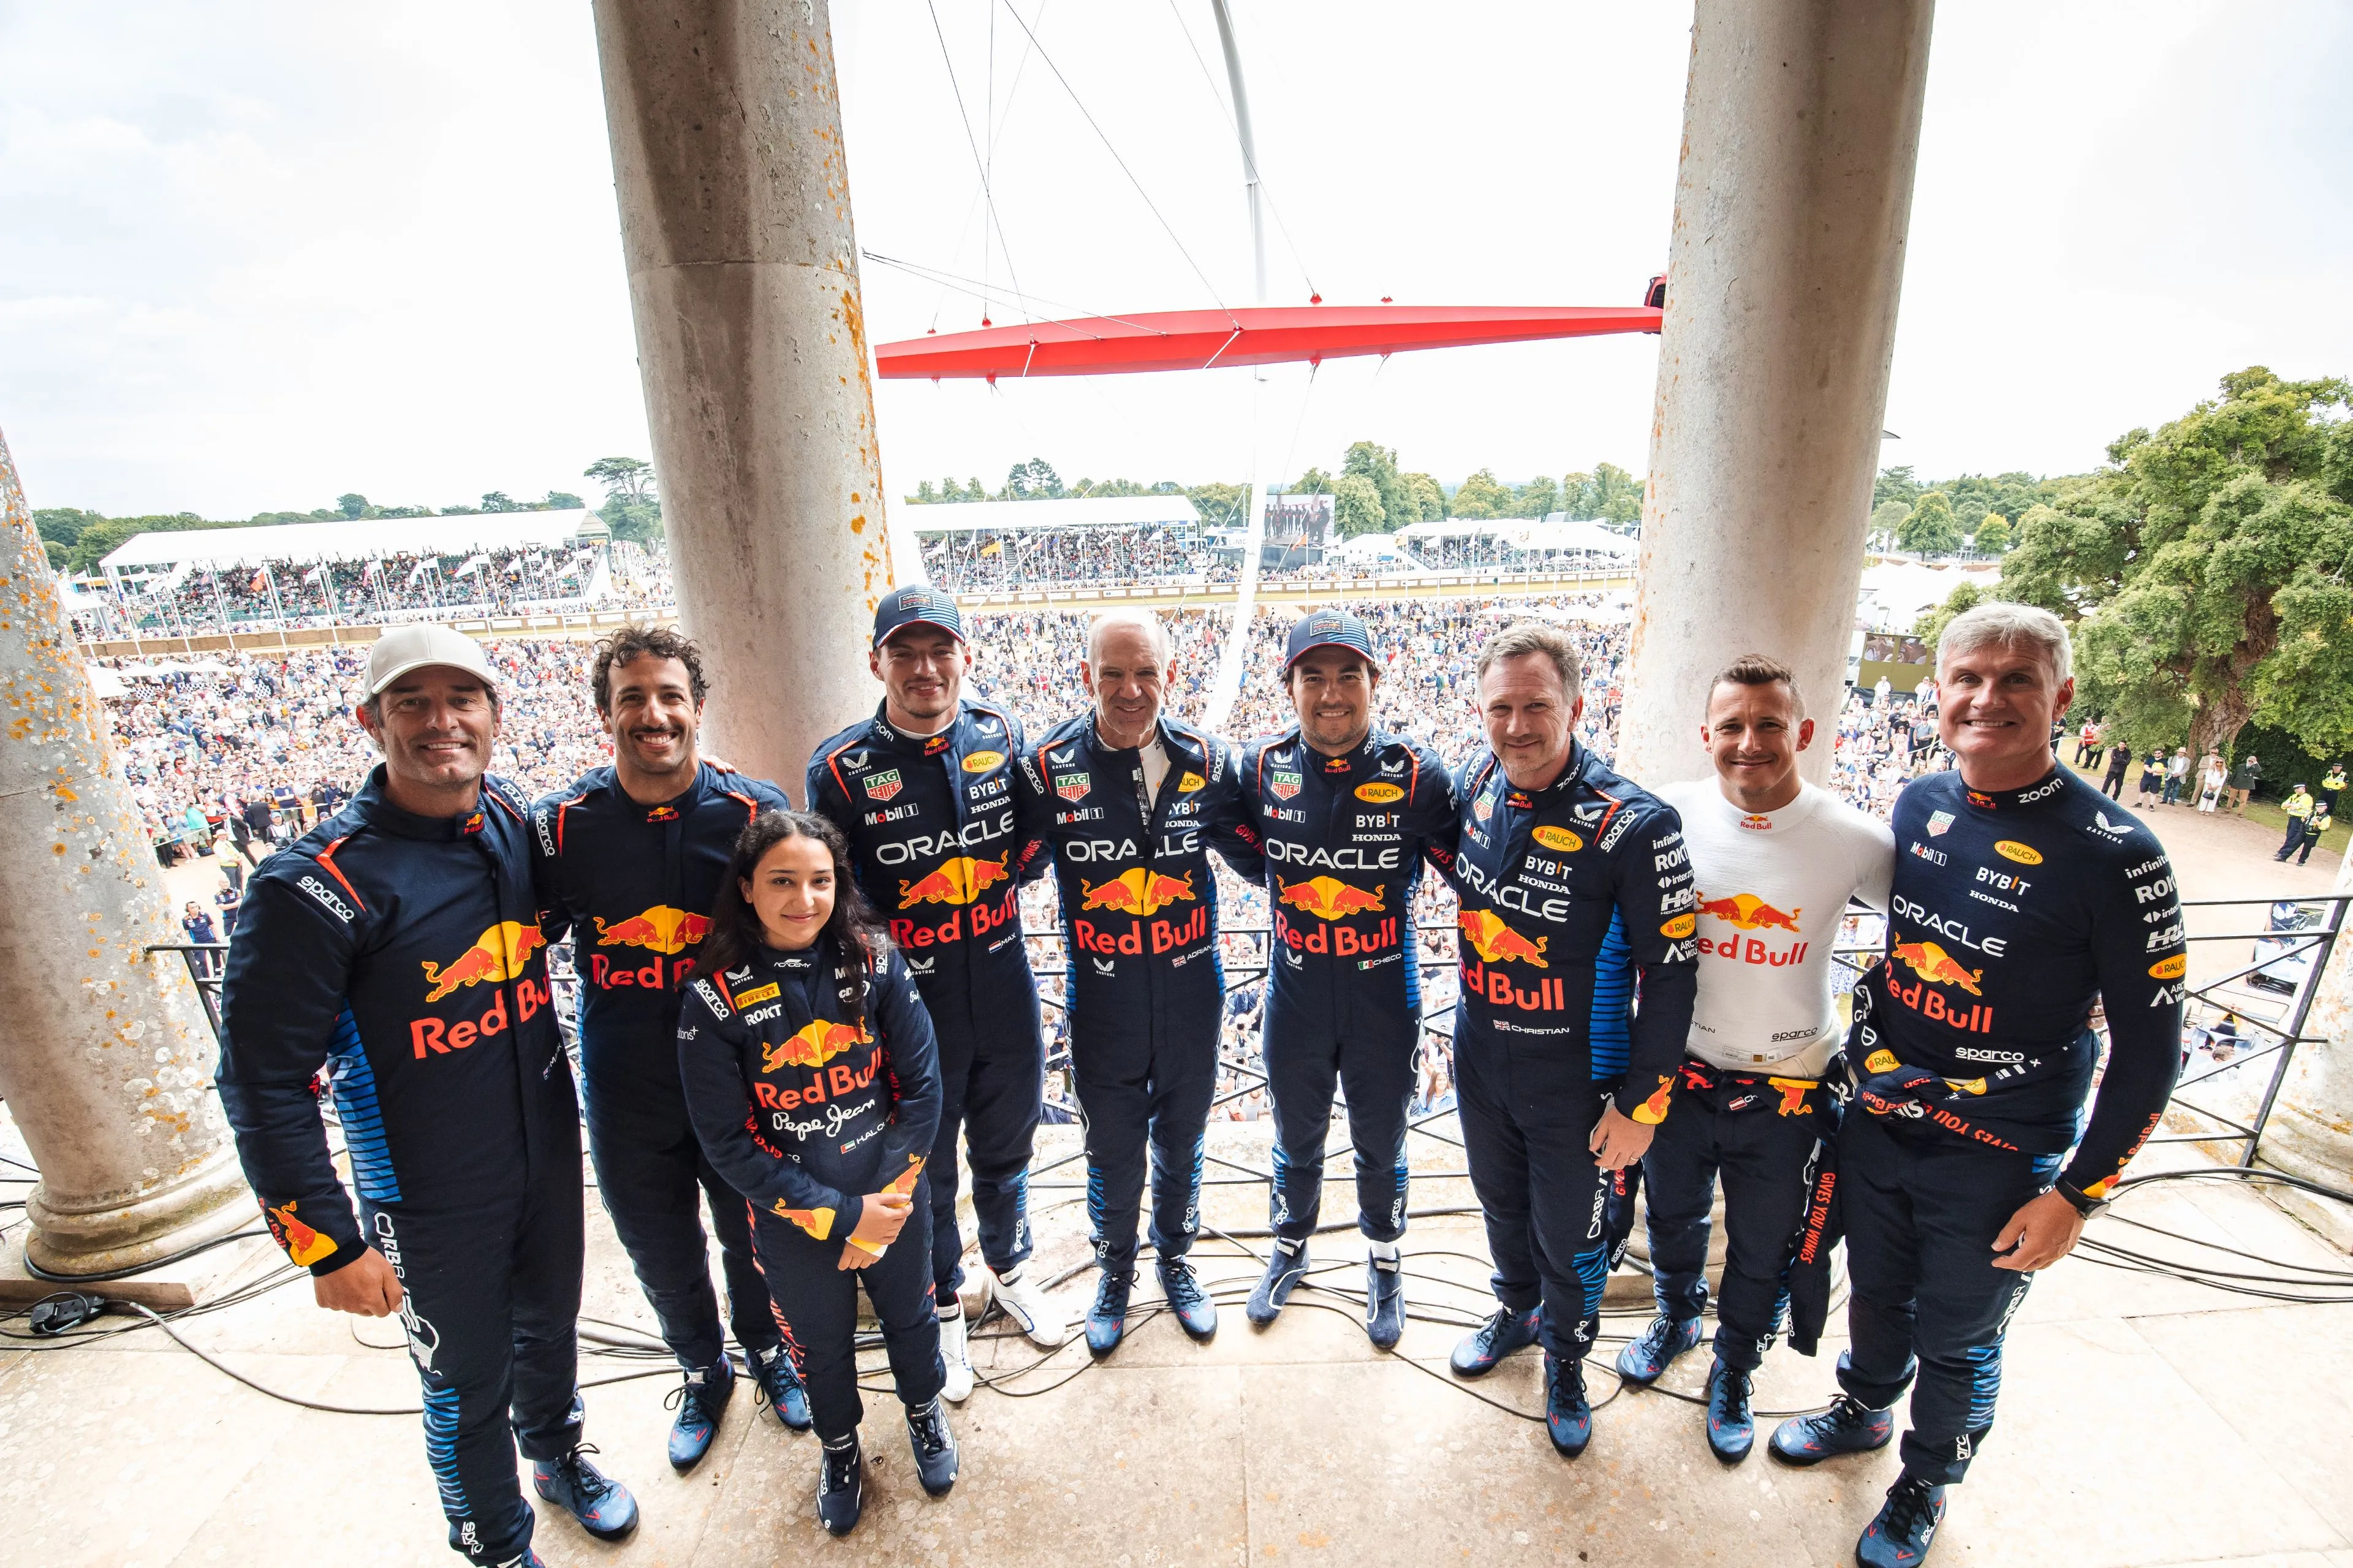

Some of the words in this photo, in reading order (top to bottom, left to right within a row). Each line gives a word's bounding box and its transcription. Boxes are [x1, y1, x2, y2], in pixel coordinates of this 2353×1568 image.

[938, 743, 949, 754] Bull
[848, 765, 872, 776] CASTORE
[974, 754, 999, 768] RAUCH
[1212, 744, 1226, 782] sparco
[866, 770, 897, 787] TAG
[1021, 756, 1044, 795] sparco
[1059, 775, 1088, 785] TAG
[1181, 778, 1200, 788] AUCH
[1275, 773, 1300, 784] TAG
[1557, 763, 1581, 791] zoom
[868, 782, 900, 798] HEUER
[969, 777, 1007, 800] BYBIT
[1059, 785, 1089, 798] HEUER
[1273, 784, 1298, 795] HEUER
[1368, 789, 1398, 797] RAUCH
[2018, 778, 2064, 804] zoom
[971, 796, 1011, 814] HONDA
[1169, 799, 1201, 816] YBIT
[1264, 805, 1293, 820] Mobil
[865, 806, 904, 826] Mobil
[1056, 808, 1089, 825] Mobil
[1356, 812, 1400, 828] BYBIT
[1570, 818, 1595, 828] CASTORE
[1740, 821, 1756, 830] Red
[1933, 812, 1953, 824] TAG
[536, 809, 555, 857] sparco
[876, 810, 1015, 865] ORACLE
[1464, 819, 1483, 844] Mobil
[1545, 831, 1577, 847] RAUCH
[1600, 809, 1638, 853] sparco
[2086, 826, 2123, 844] CASTORE
[1066, 831, 1199, 862] ORALE
[1266, 838, 1400, 869] ORACLE
[1910, 841, 1934, 862] Mobil
[2006, 845, 2037, 863] RAUCH
[1525, 855, 1572, 880] BYBIT
[1456, 852, 1571, 923] ORACLE
[1518, 874, 1571, 895] HONDA
[1976, 866, 2031, 896] BYBIT
[2135, 873, 2177, 904] ROK
[297, 876, 355, 923] sparco
[1969, 890, 2019, 913] HONDA
[889, 909, 961, 949] Red
[970, 884, 1018, 937] Bull
[1893, 895, 2007, 957] ORACLE
[1001, 932, 1017, 947] MAX
[1074, 918, 1143, 955] Red
[1151, 905, 1206, 955] Bull
[1275, 909, 1328, 954] Red
[1334, 917, 1397, 956] Bull
[1187, 944, 1213, 960] ADRIAN
[1373, 953, 1402, 966] CHECO
[1698, 934, 1740, 960] ed
[1745, 938, 1809, 968] Bull
[2146, 944, 2172, 954] Honda
[590, 953, 664, 990] Red
[2164, 958, 2186, 973] RAUC
[732, 975, 753, 987] CASTORE
[1458, 957, 1483, 994] ed
[1488, 970, 1564, 1011] Bull
[694, 979, 729, 1021] sparco
[738, 985, 776, 1006] PIRELLI
[410, 989, 509, 1059] Red
[517, 979, 551, 1023] Bu
[745, 1004, 782, 1026] ROKT
[1923, 988, 1993, 1033] Bull
[1511, 1025, 1570, 1035] CHRISTIAN
[1771, 1027, 1818, 1042] sparco
[1955, 1047, 2025, 1063] sparco
[754, 1072, 826, 1110] Red
[828, 1046, 882, 1097] Bull
[772, 1112, 825, 1141] Pepe
[1933, 1109, 1970, 1135] YOU
[1815, 1172, 1837, 1204] GIVES
[1809, 1205, 1828, 1231] YOU
[1611, 1238, 1627, 1263] sparco
[1800, 1227, 1824, 1263] WINGS
